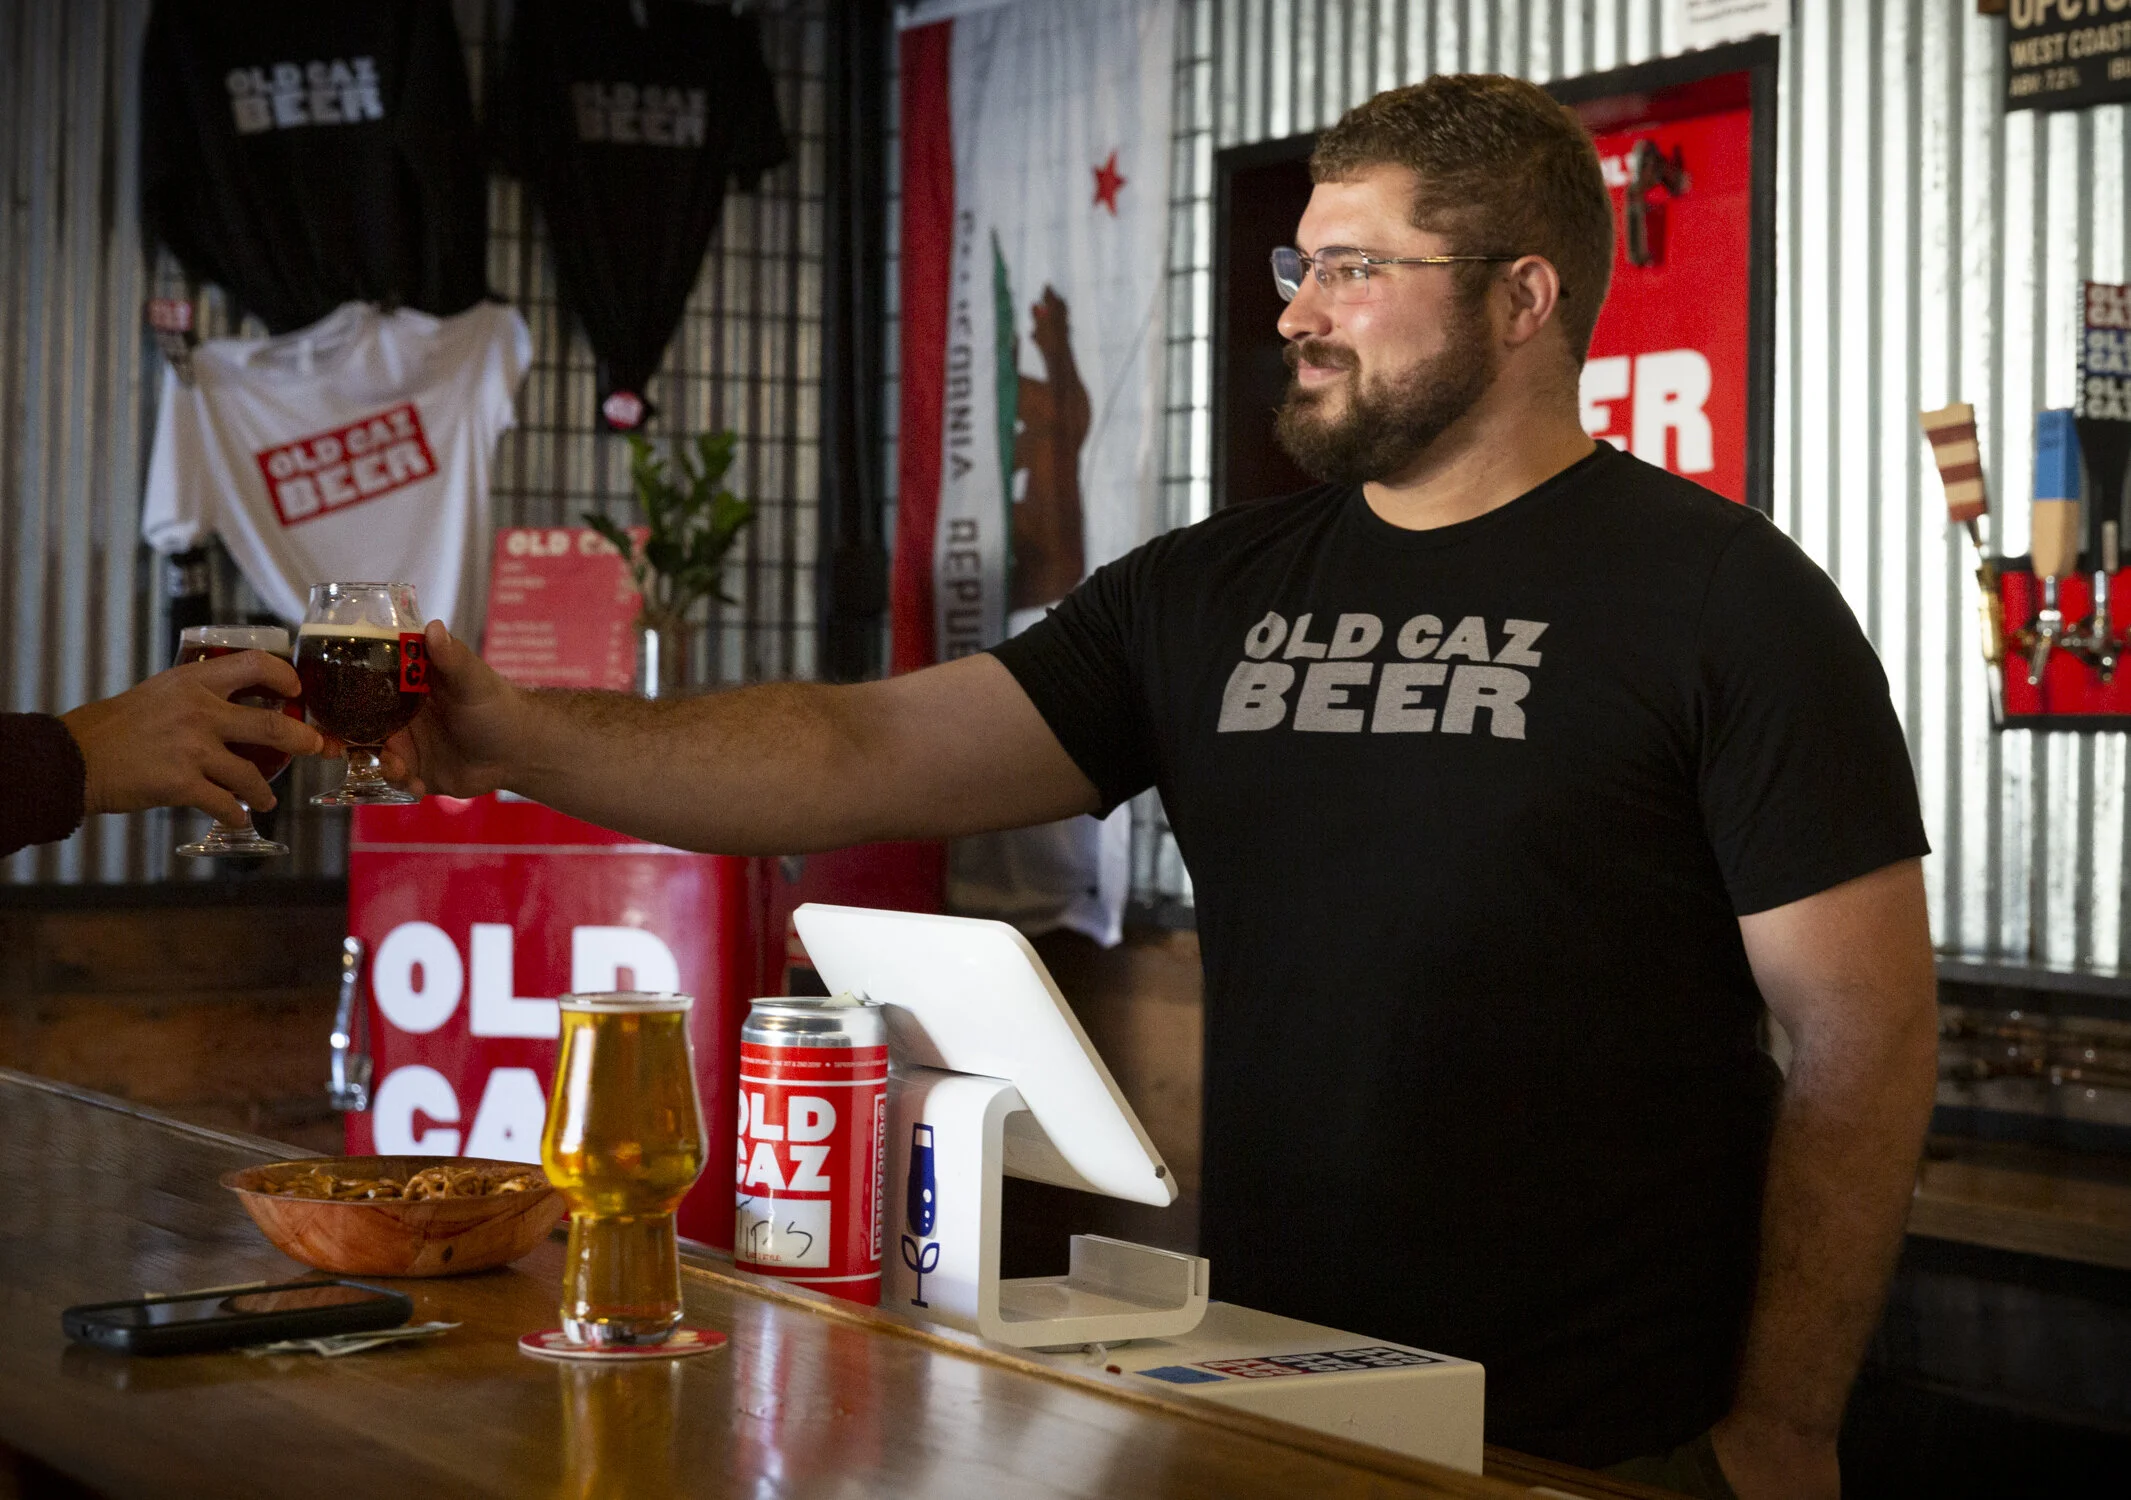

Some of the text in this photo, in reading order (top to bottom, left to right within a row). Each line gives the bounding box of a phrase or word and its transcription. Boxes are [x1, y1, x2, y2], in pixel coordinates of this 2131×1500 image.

[2009, 33, 2067, 68] WEST
[224, 61, 301, 98] OLD
[229, 88, 384, 136] BEER
[268, 437, 341, 479] OLD
[278, 439, 427, 520] BEER
[506, 531, 570, 557] OLD
[1244, 610, 1550, 668] OLD CAZ
[1216, 660, 1532, 740] BEER
[373, 920, 681, 1039] OLD
